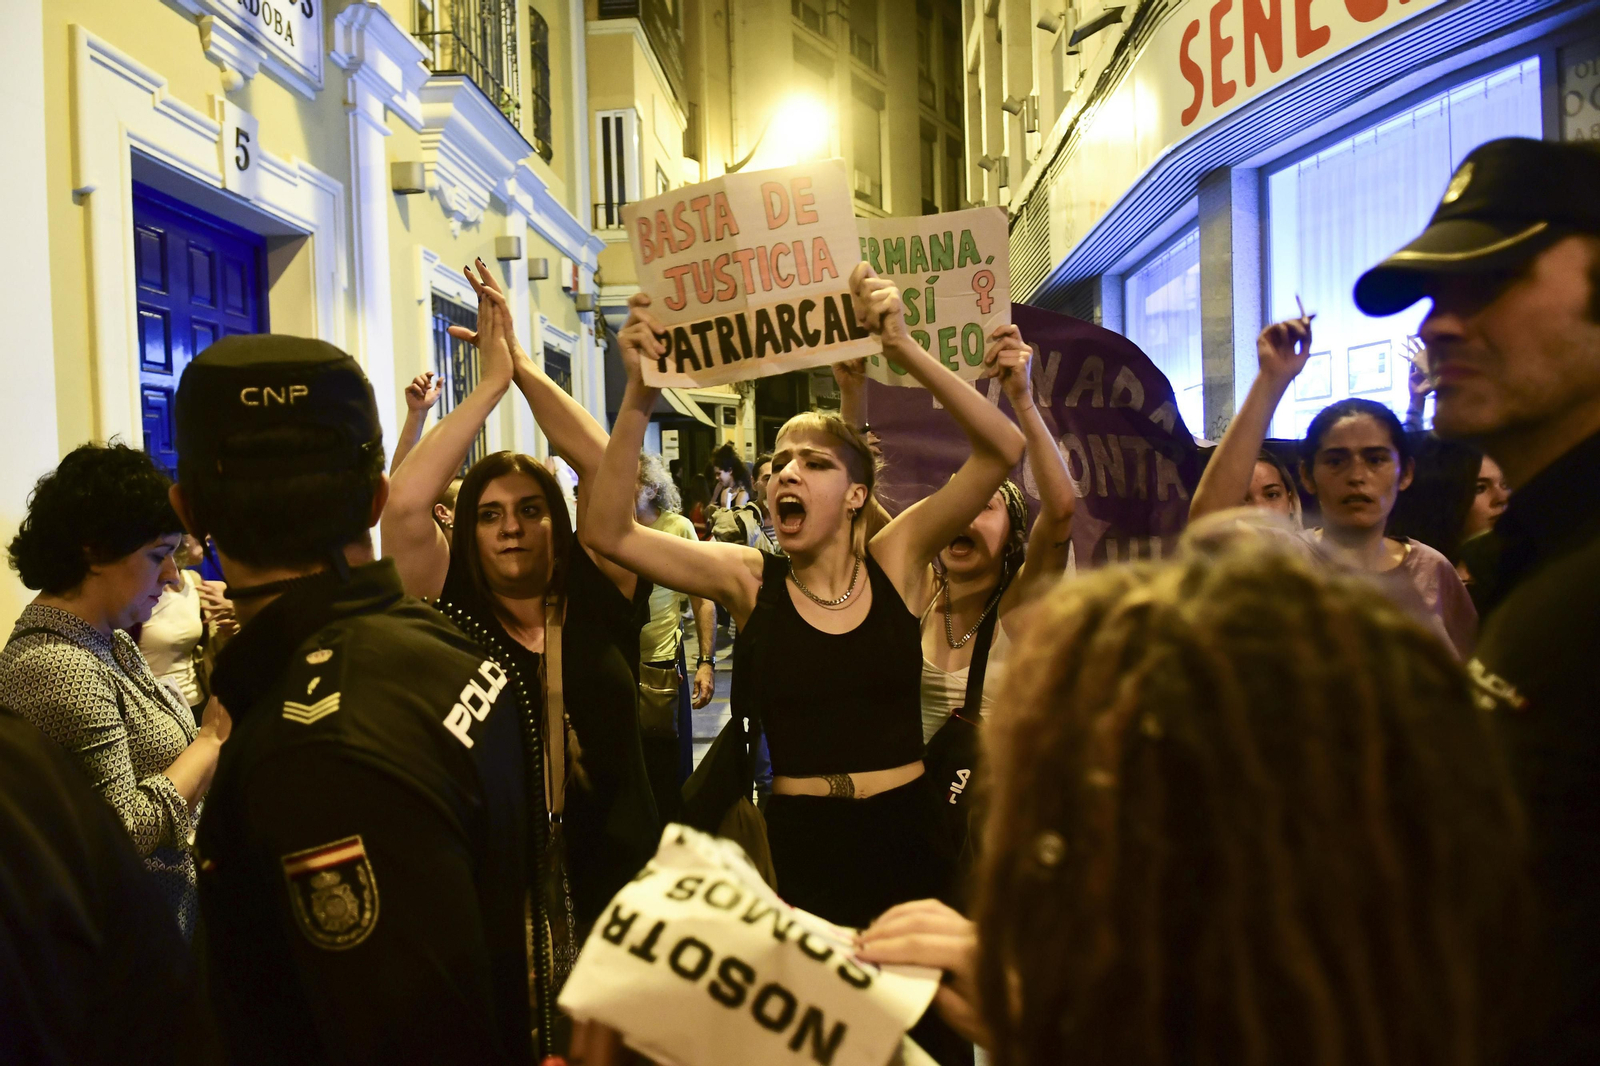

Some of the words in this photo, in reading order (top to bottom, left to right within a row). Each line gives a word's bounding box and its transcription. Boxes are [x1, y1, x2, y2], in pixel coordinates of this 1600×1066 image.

[235, 127, 250, 171] 5
[636, 192, 739, 265] BASTA
[761, 177, 818, 230] DE
[664, 236, 839, 311] JUSTICIA
[652, 293, 872, 373] PATRIARCAL
[240, 385, 308, 406] CNP
[946, 768, 971, 805] FILA
